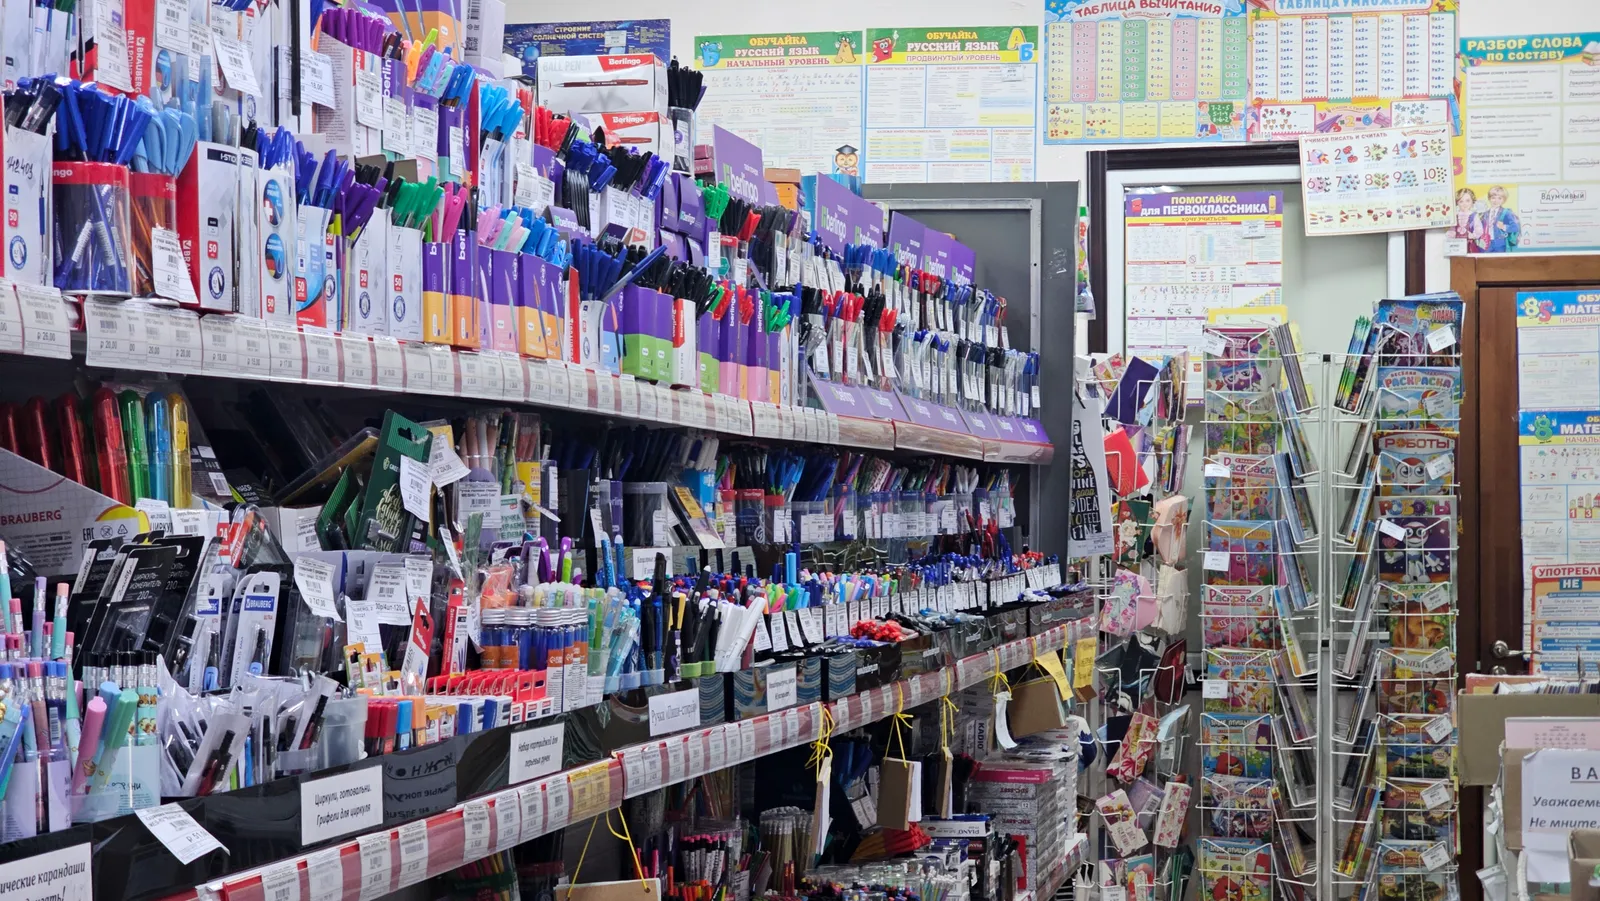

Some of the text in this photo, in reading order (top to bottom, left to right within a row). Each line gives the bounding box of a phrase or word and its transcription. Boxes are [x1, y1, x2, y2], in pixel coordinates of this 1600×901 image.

[1075, 0, 1136, 18] ТАБЛИЦА
[750, 34, 807, 46] ОБУЧАЙКА
[926, 31, 978, 40] ОБУЧАЙКА
[907, 41, 998, 52] РУССКИЙ ЯЗЫК
[1467, 37, 1582, 51] РАЗБОР СЛОВА
[735, 46, 820, 57] РУССКИЙ ЯЗЫК
[1487, 50, 1564, 61] по составу
[726, 58, 830, 68] НАЧАЛЬНЫЙ УРОВЕНЬ
[906, 54, 964, 62] ПРОДВИНУТЫЙ
[136, 45, 144, 93] BRAUBERG
[1171, 195, 1237, 204] ПОМОГАЙКА
[1541, 192, 1584, 200] Вдумчивый
[1141, 204, 1267, 216] для ПЕРВОКЛАССНИКА
[826, 208, 846, 242] berlingo
[1385, 376, 1452, 388] РАСКРАСКА
[1385, 438, 1449, 448] РОБОТЫ
[1, 510, 62, 526] BRAUBERG
[1563, 579, 1580, 588] НЕ
[250, 598, 272, 608] BRAUBERG
[315, 792, 338, 806] Циркули,
[317, 804, 371, 826] Грифели для циркуля
[1529, 818, 1546, 828] Не
[38, 862, 86, 885] карандаши
